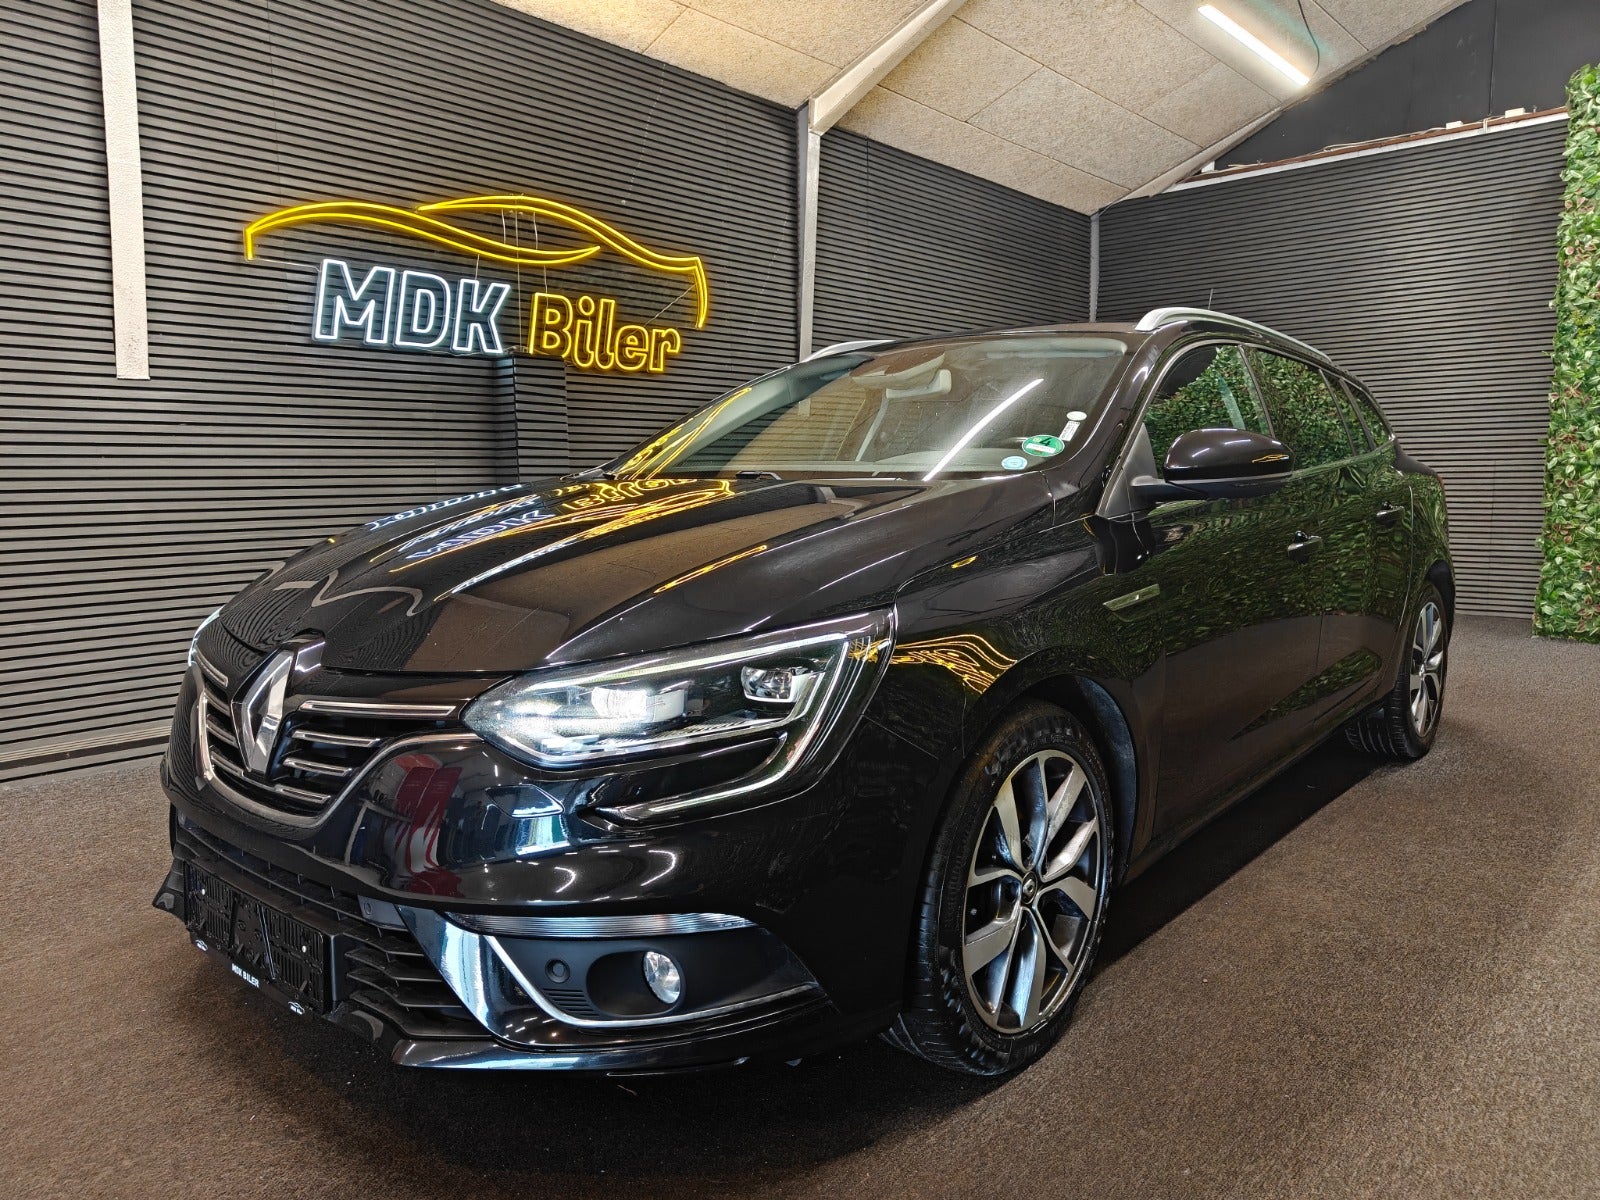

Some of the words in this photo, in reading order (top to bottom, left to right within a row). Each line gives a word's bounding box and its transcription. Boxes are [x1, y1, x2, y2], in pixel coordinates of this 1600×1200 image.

[313, 258, 511, 355] MDK
[528, 292, 682, 374] Biler
[1039, 437, 1053, 447] 4
[242, 970, 260, 989] BILER
